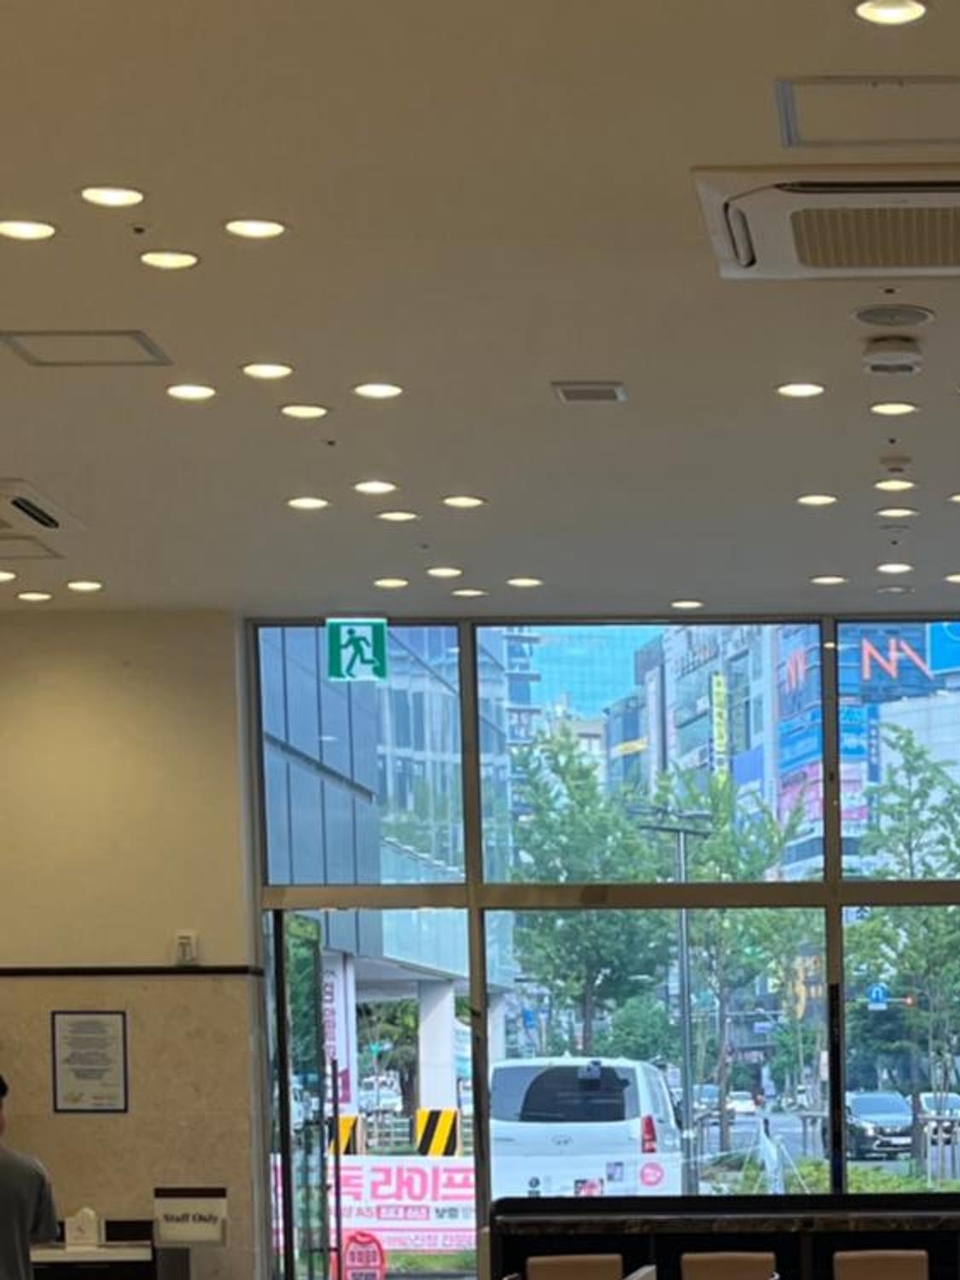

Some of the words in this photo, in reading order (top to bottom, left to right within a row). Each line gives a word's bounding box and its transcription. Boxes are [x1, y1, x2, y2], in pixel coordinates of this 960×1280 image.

[370, 1165, 474, 1201] 라이프
[163, 1212, 190, 1224] Staff
[191, 1212, 219, 1226] Only
